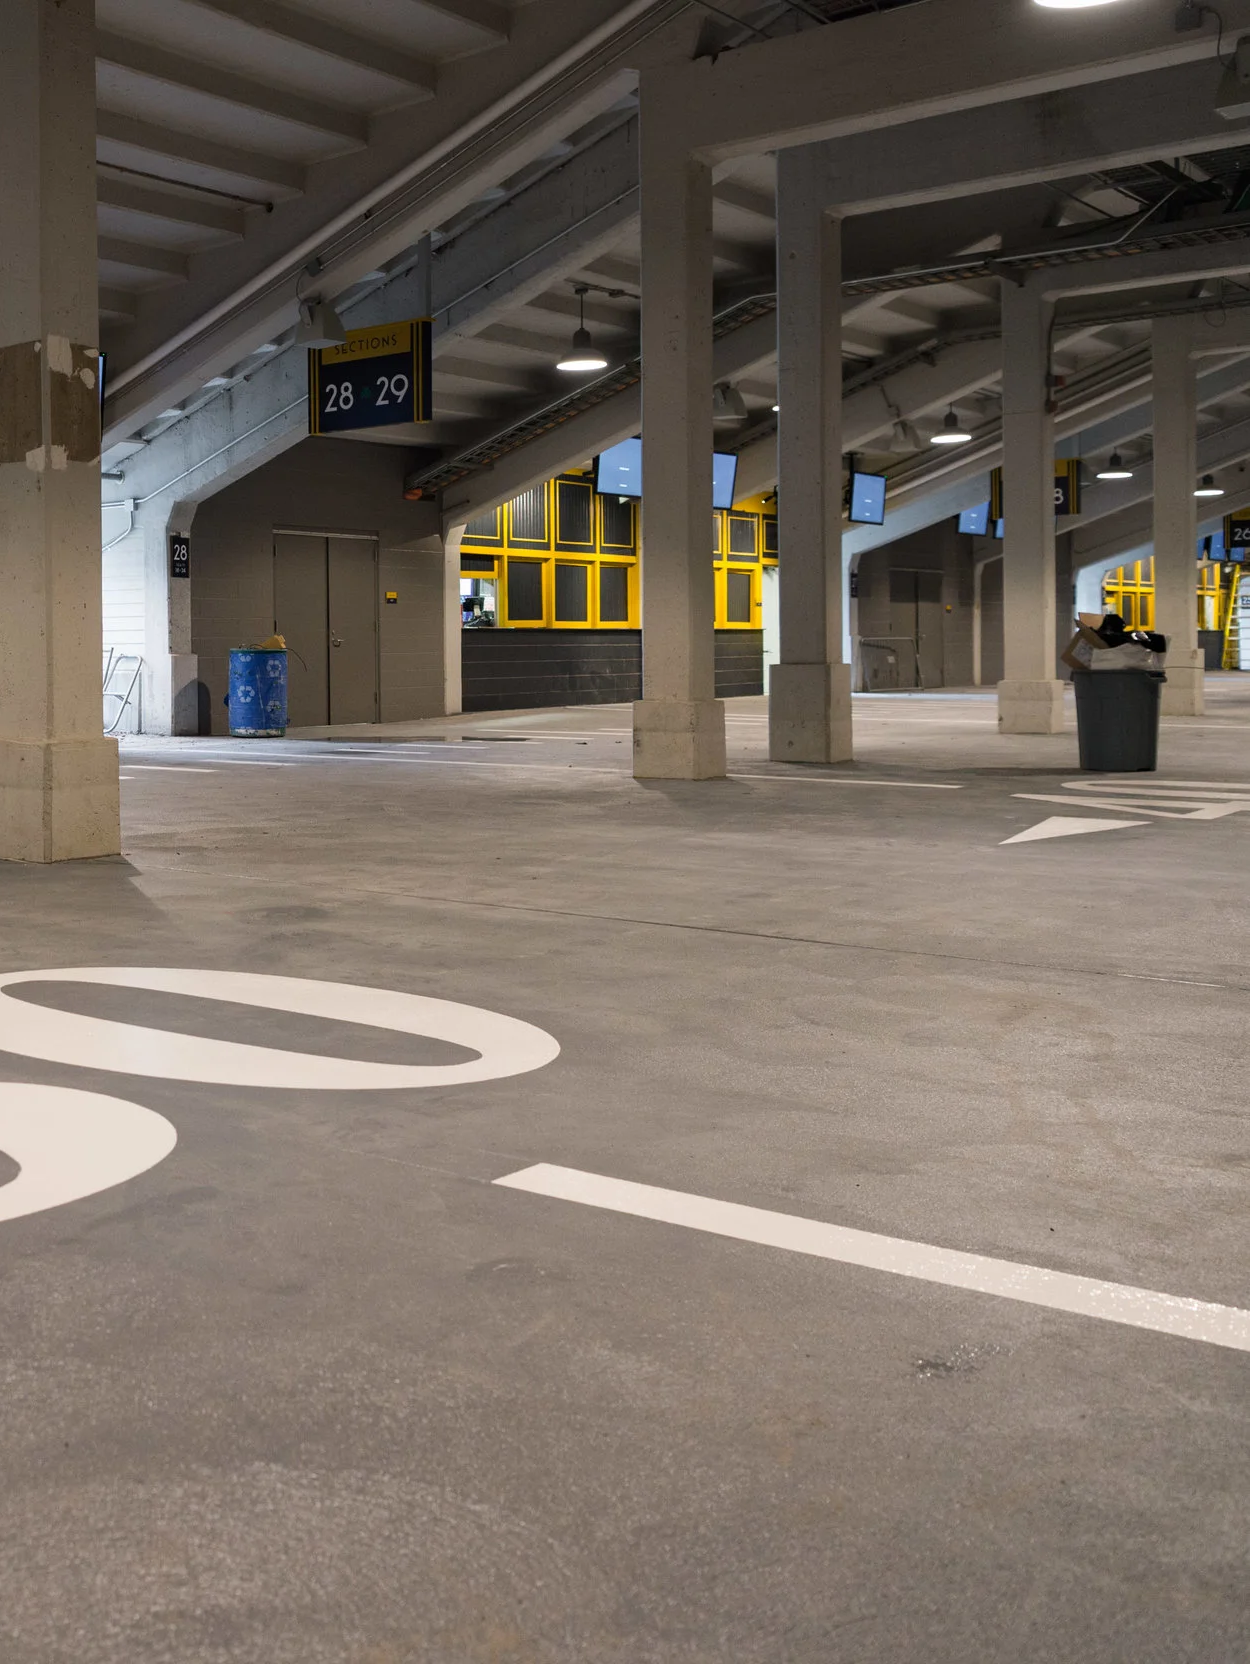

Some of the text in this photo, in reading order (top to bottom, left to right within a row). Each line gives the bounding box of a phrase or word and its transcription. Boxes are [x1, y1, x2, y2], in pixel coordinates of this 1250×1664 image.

[334, 334, 398, 355] SECTIONS
[324, 374, 409, 413] 28 29
[174, 544, 188, 561] 28
